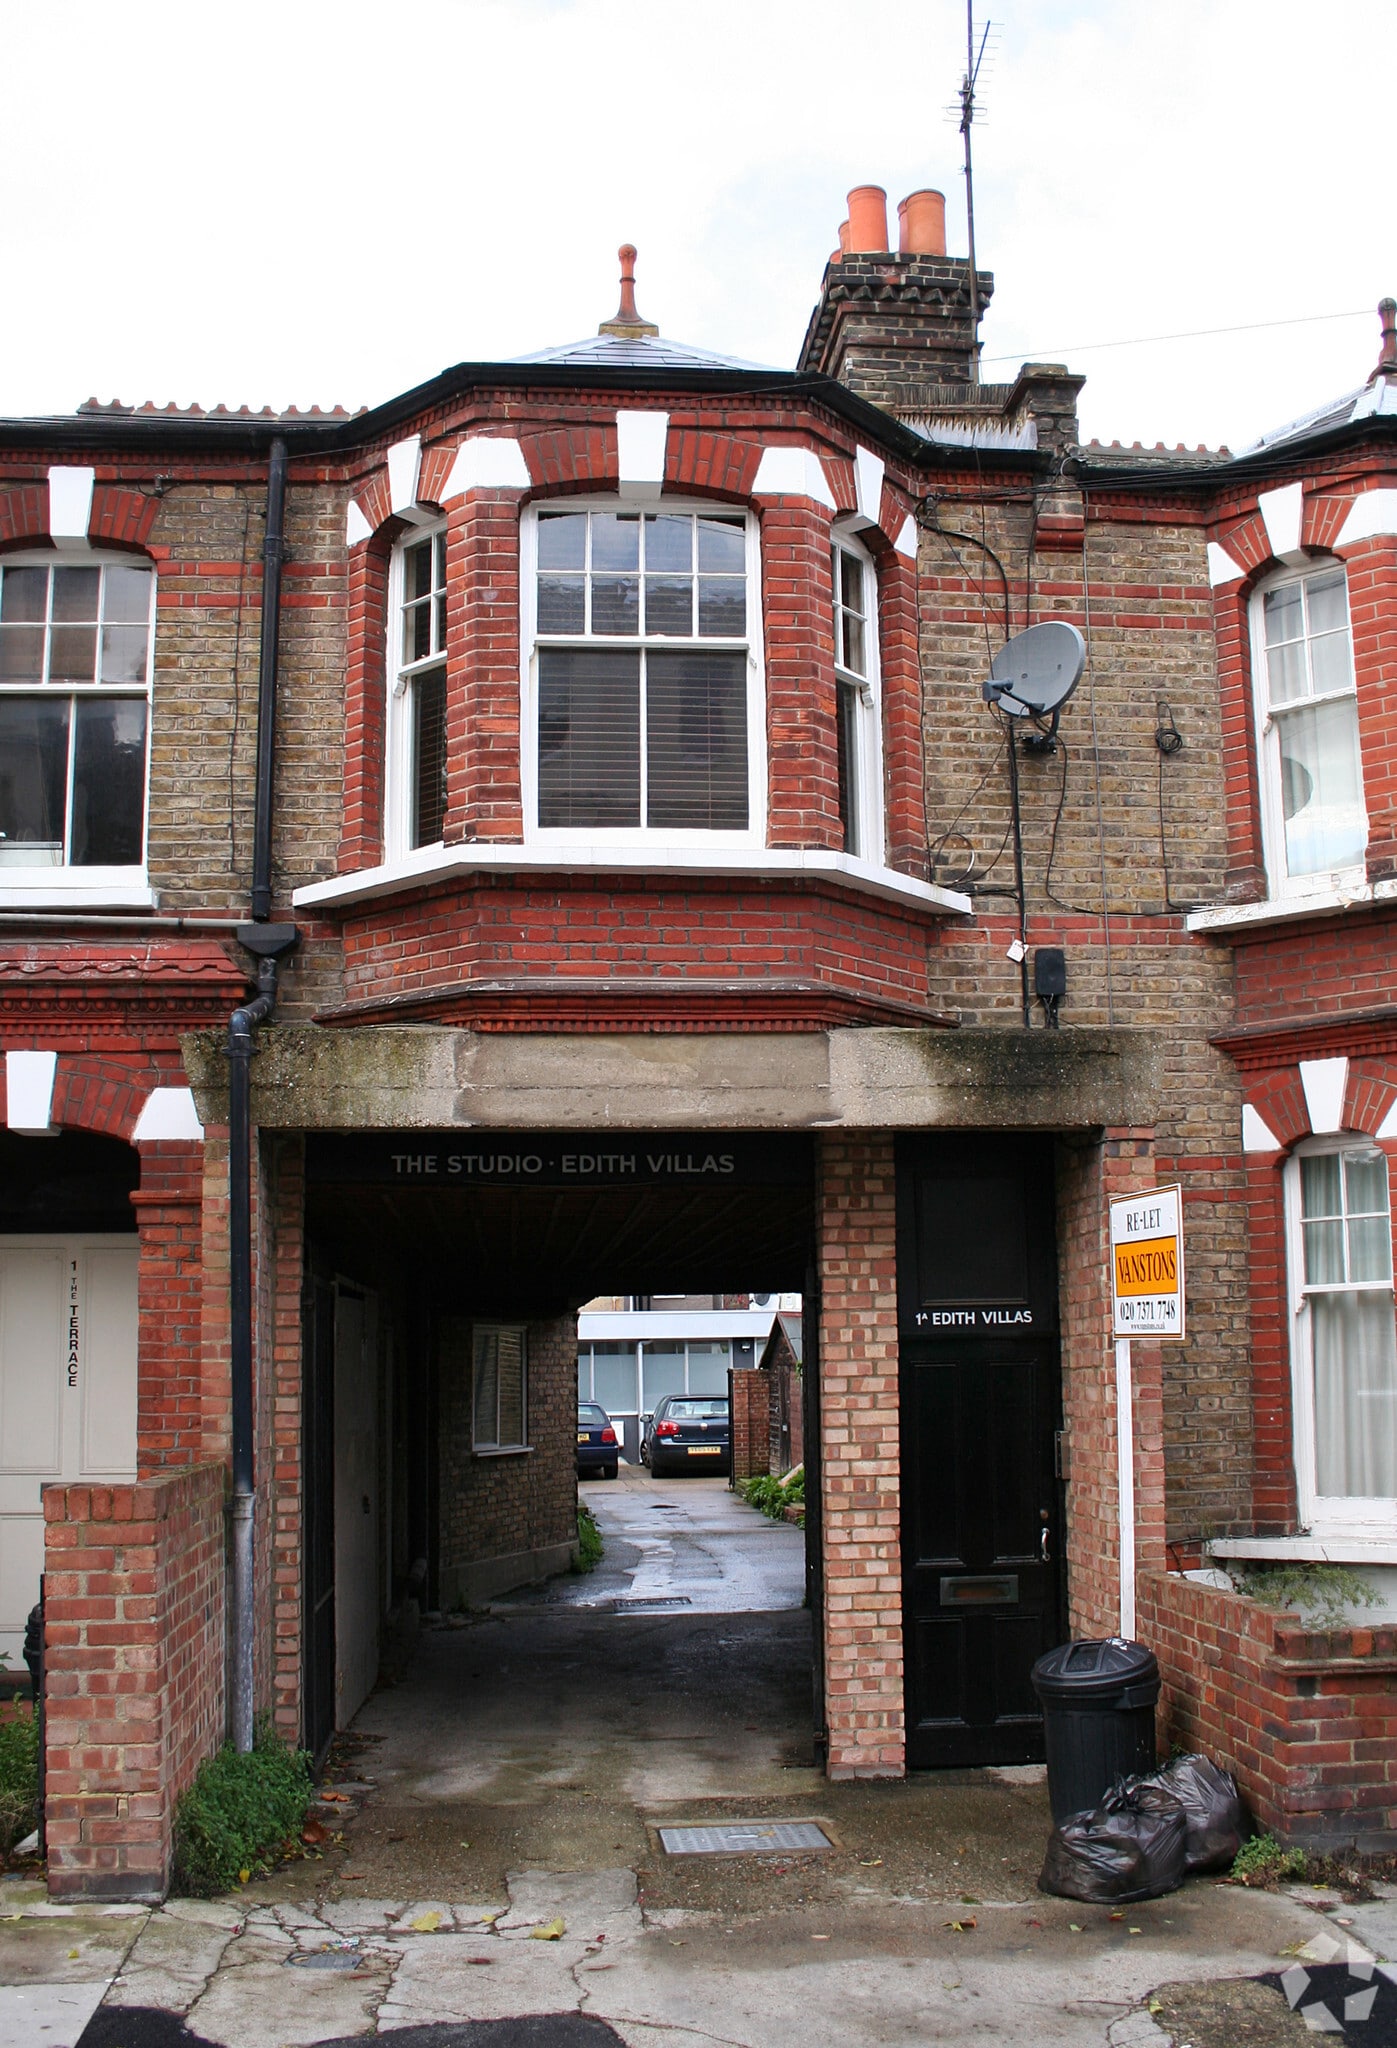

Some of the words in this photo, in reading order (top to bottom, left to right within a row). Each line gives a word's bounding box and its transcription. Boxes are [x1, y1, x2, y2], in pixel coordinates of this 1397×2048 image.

[391, 1155, 438, 1173] THE
[447, 1155, 543, 1174] STUDIO
[561, 1154, 636, 1173] EDITH
[647, 1154, 735, 1173] VILLAS
[71, 1261, 77, 1271] 1
[1118, 1250, 1176, 1284] VANSTONS
[932, 1312, 975, 1325] EDITH
[982, 1311, 1033, 1324] VILLAS
[1120, 1302, 1135, 1320] 020
[1137, 1301, 1154, 1320] 7371
[1158, 1300, 1176, 1319] 7748
[68, 1305, 79, 1387] TERRACE
